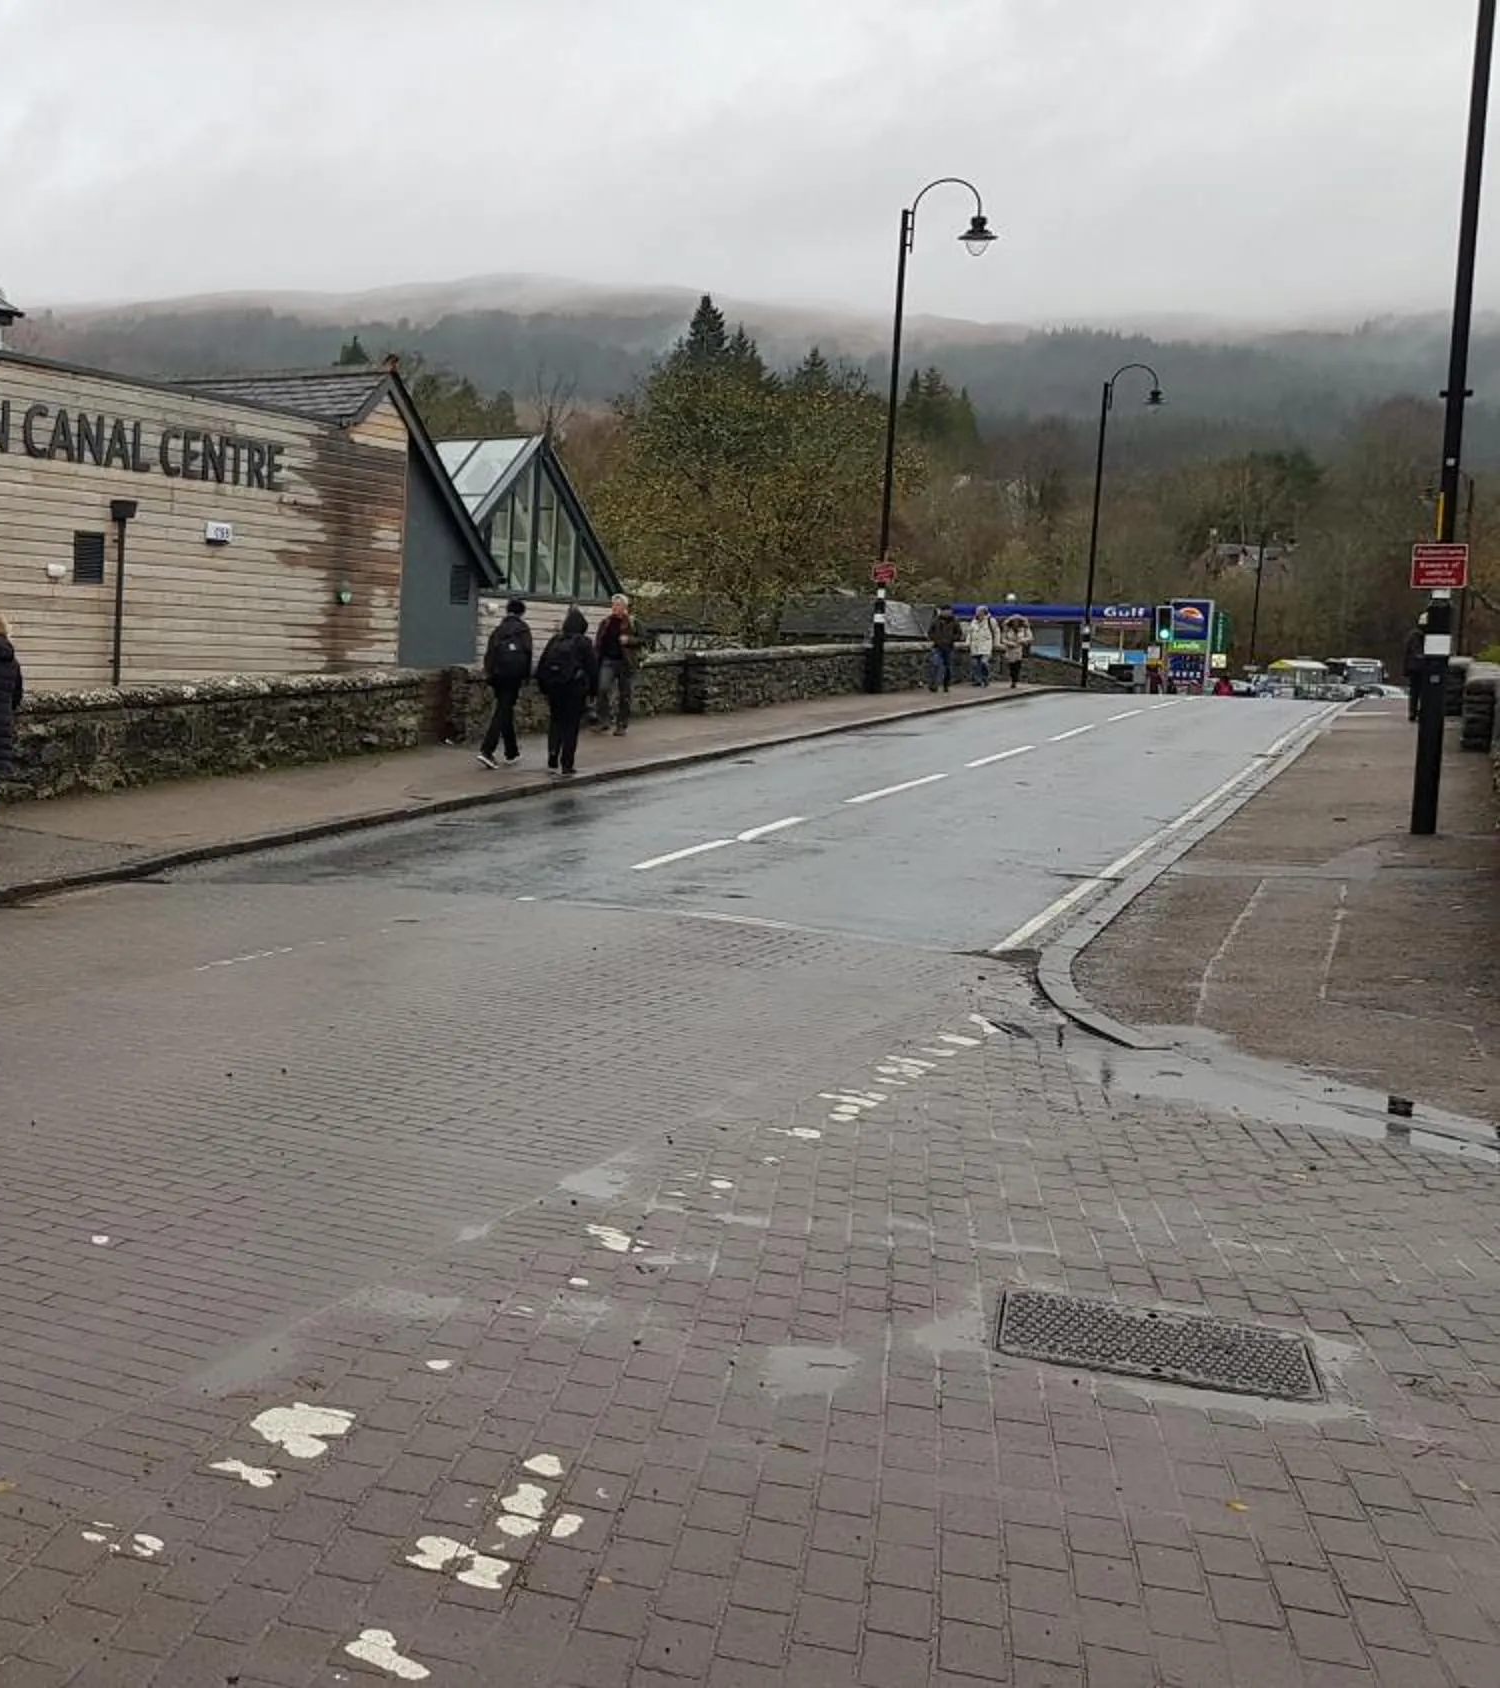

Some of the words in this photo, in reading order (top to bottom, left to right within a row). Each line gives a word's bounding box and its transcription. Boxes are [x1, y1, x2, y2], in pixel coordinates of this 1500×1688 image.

[23, 404, 151, 473] CANAL
[159, 429, 285, 491] CENTRE
[1103, 606, 1146, 618] Gulf
